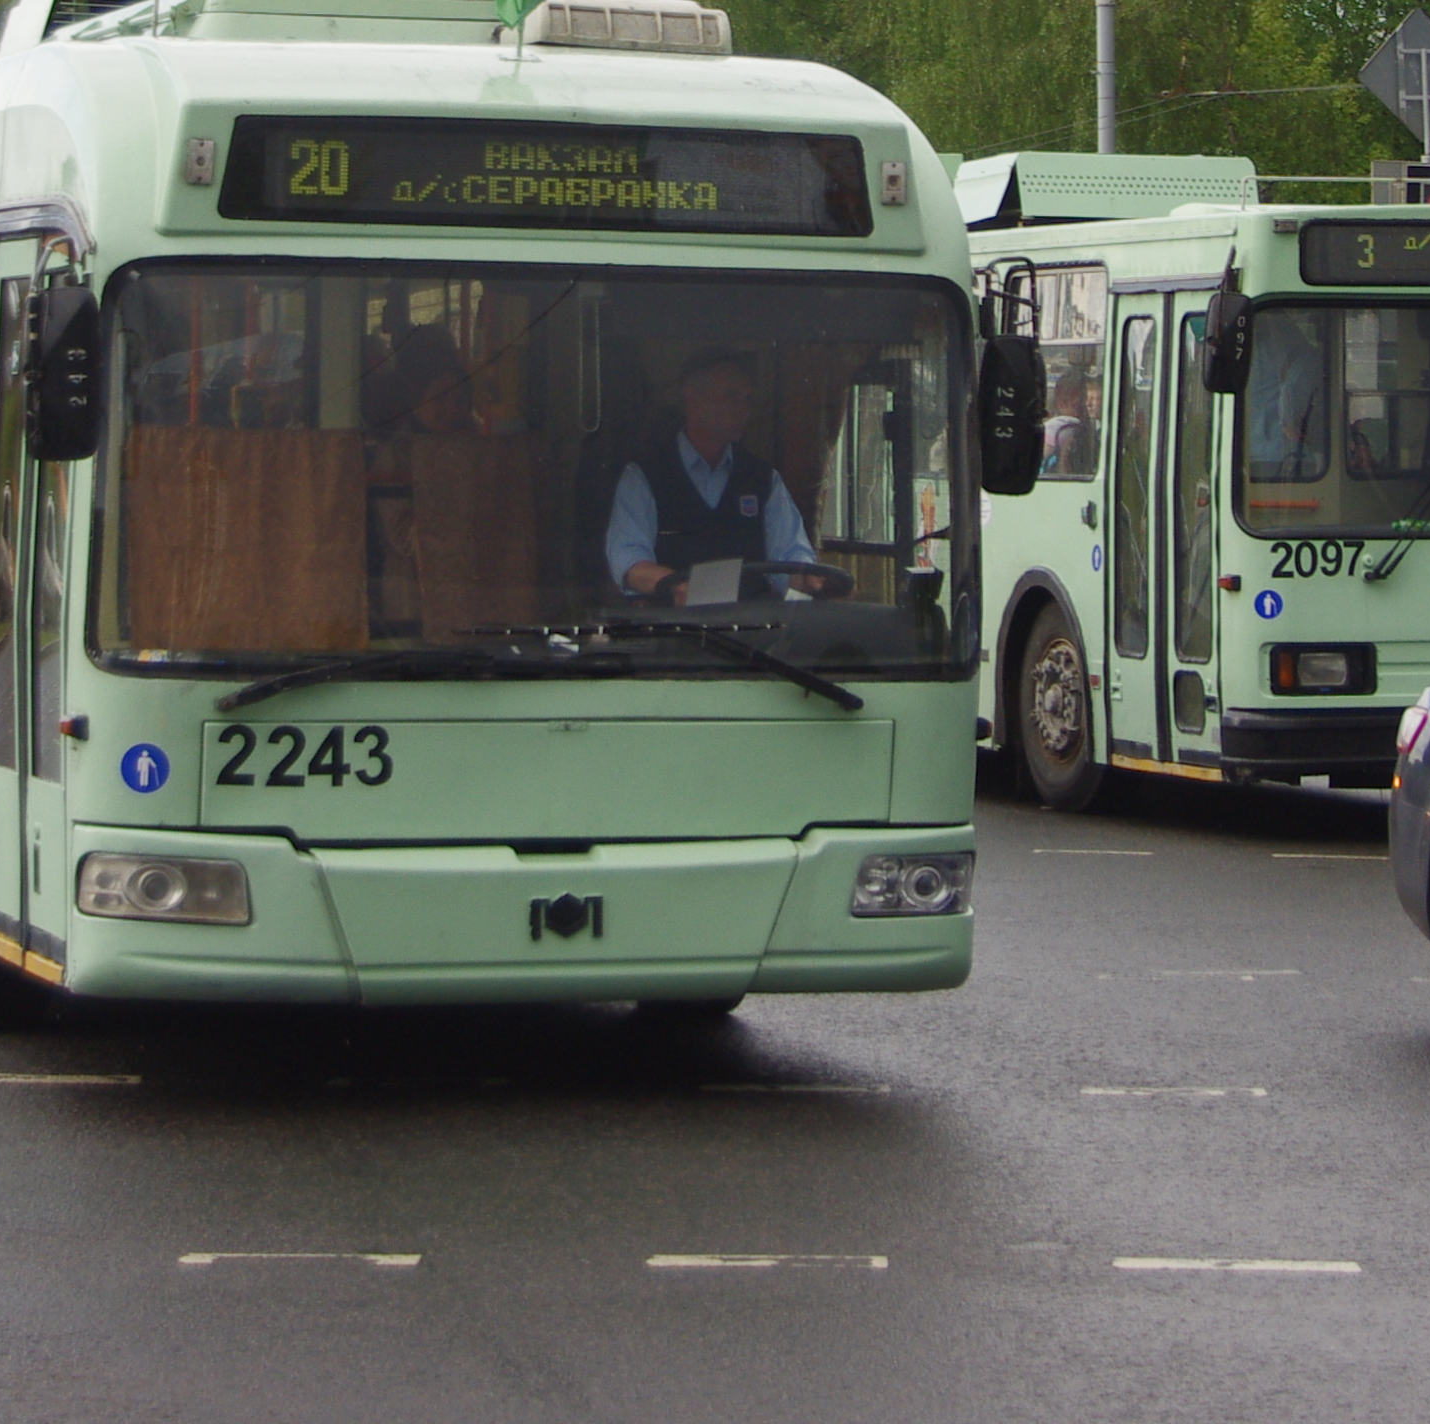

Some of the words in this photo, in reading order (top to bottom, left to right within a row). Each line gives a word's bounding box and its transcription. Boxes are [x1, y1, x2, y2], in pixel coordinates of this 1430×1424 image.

[290, 139, 349, 195] 20
[484, 142, 638, 173] ВАКЗАЛ
[1357, 233, 1375, 269] 3
[1235, 315, 1247, 361] 097
[66, 347, 88, 407] 243
[994, 386, 1016, 439] 243
[1270, 540, 1366, 579] 2097
[216, 723, 394, 787] 2243
